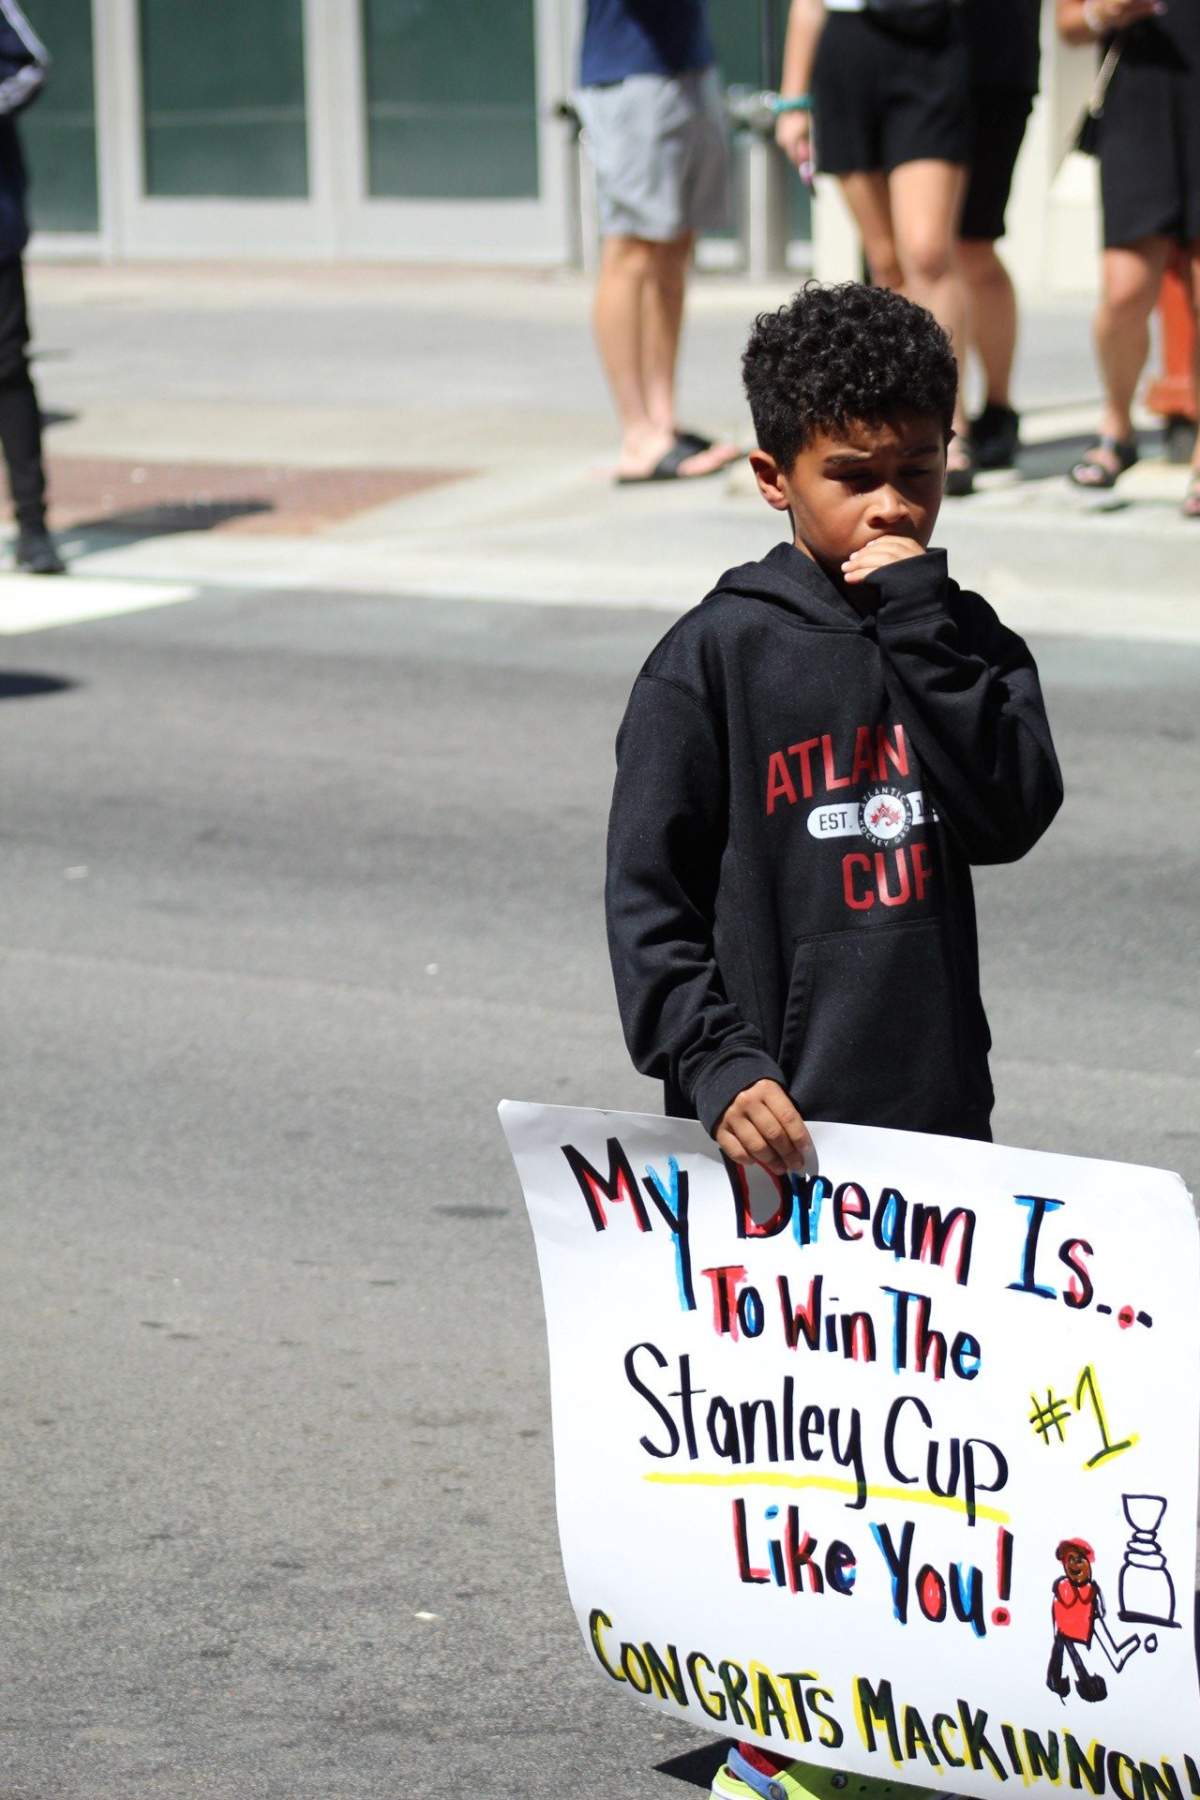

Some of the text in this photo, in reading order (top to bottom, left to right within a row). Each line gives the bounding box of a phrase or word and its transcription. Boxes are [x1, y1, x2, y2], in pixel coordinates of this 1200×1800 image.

[766, 724, 909, 816] ATLAN
[819, 811, 853, 831] EST.
[859, 820, 889, 847] HOCKEY
[561, 1137, 697, 1312] My
[719, 1148, 976, 1286] Dream
[701, 1264, 982, 1382] To Win The
[623, 1342, 1009, 1527] Stanley Cup
[1028, 1361, 1140, 1471] #1
[731, 1497, 1013, 1639] Like You!
[589, 1608, 844, 1749] CONGRATS
